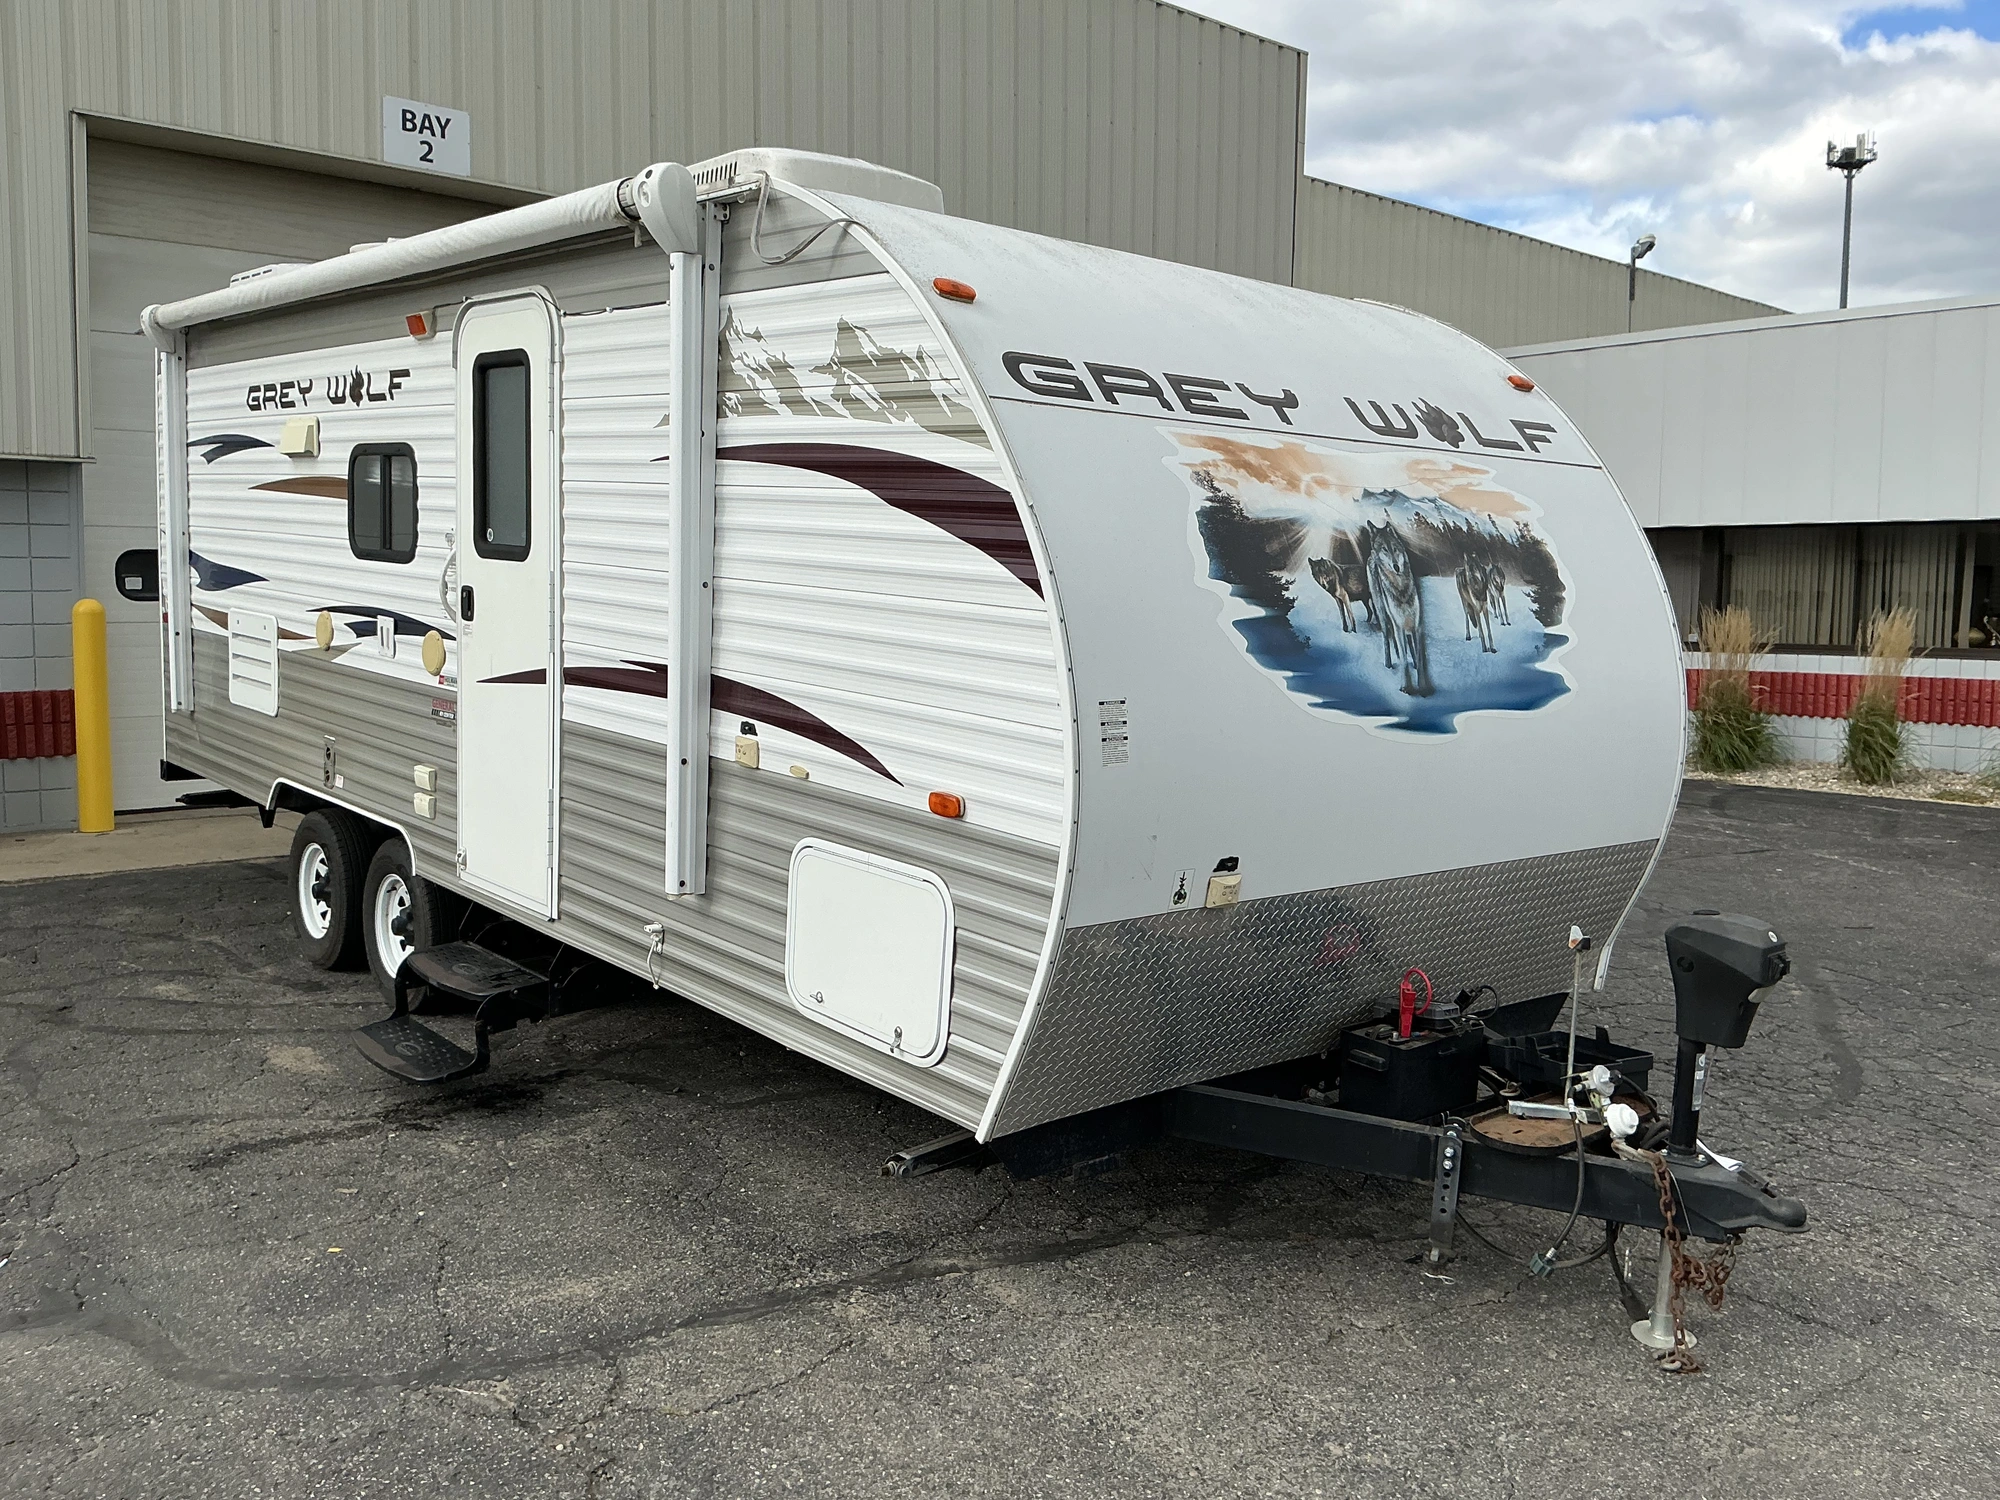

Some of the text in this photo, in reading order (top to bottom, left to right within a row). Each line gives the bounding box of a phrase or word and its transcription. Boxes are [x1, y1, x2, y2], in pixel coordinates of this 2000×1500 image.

[401, 108, 452, 140] BAY
[419, 140, 434, 164] 2
[246, 378, 313, 412] GREY
[1000, 349, 1301, 426] GREY
